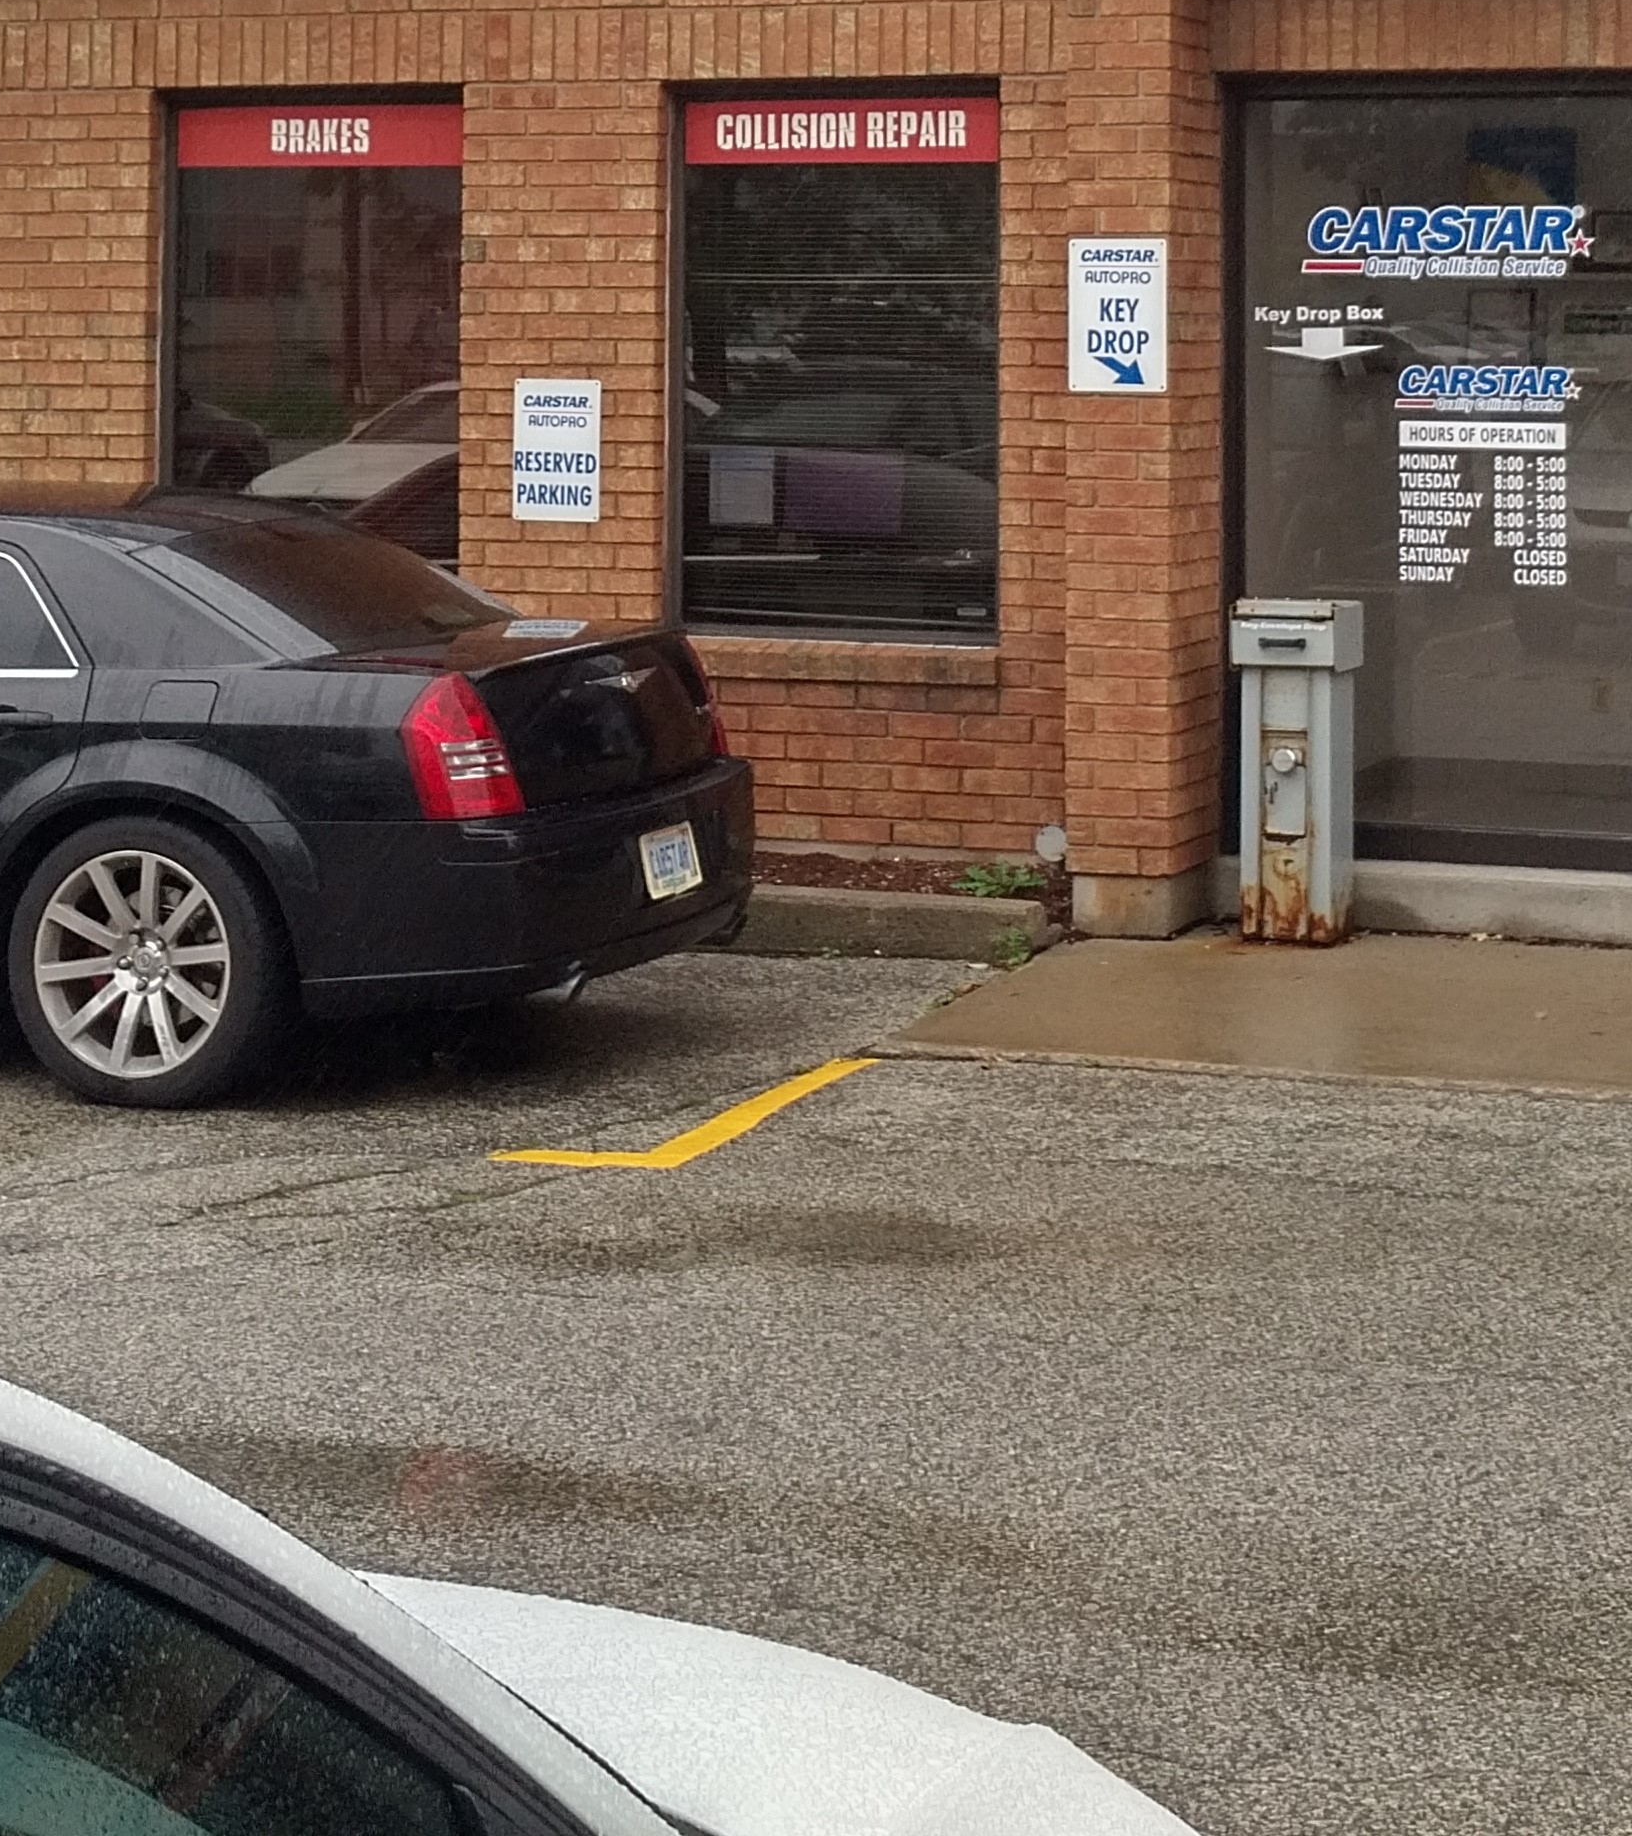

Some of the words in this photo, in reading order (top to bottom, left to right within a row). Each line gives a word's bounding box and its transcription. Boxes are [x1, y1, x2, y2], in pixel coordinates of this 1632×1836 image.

[270, 116, 370, 155] BRAKES
[716, 111, 856, 152] COLLISION
[866, 109, 967, 149] REPAIR
[1307, 205, 1575, 255] CARSTAR
[1081, 249, 1155, 263] CARSTAR
[1084, 270, 1151, 285] AUTOPRO
[1365, 257, 1424, 279] Quality
[1426, 256, 1498, 276] Collision
[1502, 256, 1566, 276] Service
[1099, 297, 1140, 323] KEY
[1254, 306, 1291, 325] Key
[1296, 305, 1342, 324] Drop
[1346, 305, 1384, 320] Box
[1087, 329, 1150, 355] DROP
[1399, 365, 1569, 397] CARSTAR
[523, 394, 589, 409] CARSTAR
[528, 414, 587, 428] AUTOPRO
[1409, 426, 1454, 442] HOURS
[1458, 427, 1476, 442] OF
[1480, 427, 1556, 444] OPERATION
[514, 450, 597, 474] RESERVED
[1399, 454, 1458, 470] MONDAY
[1494, 455, 1524, 472] 8:00
[1536, 456, 1567, 473] 5:00
[1399, 472, 1461, 489] TUESDAY
[1494, 474, 1524, 490] 8:00
[1536, 475, 1567, 491] 5:00
[516, 482, 592, 507] PARKING
[1399, 491, 1483, 508] WEDNESDAY
[1494, 493, 1524, 509] 8:00
[1536, 494, 1567, 510] 5:00
[1399, 510, 1472, 528] THURSDAY
[1494, 512, 1524, 528] 8:00
[1536, 513, 1567, 529] 5:00
[1399, 528, 1448, 544] FRIDAY
[1494, 531, 1524, 547] 8:00
[1536, 532, 1567, 548] 5:00
[1399, 547, 1471, 564] SATURDAY
[1513, 549, 1567, 566] CLOSED
[1399, 565, 1455, 582] SUNDAY
[1513, 568, 1567, 585] CLOSED
[1303, 623, 1327, 631] Drop
